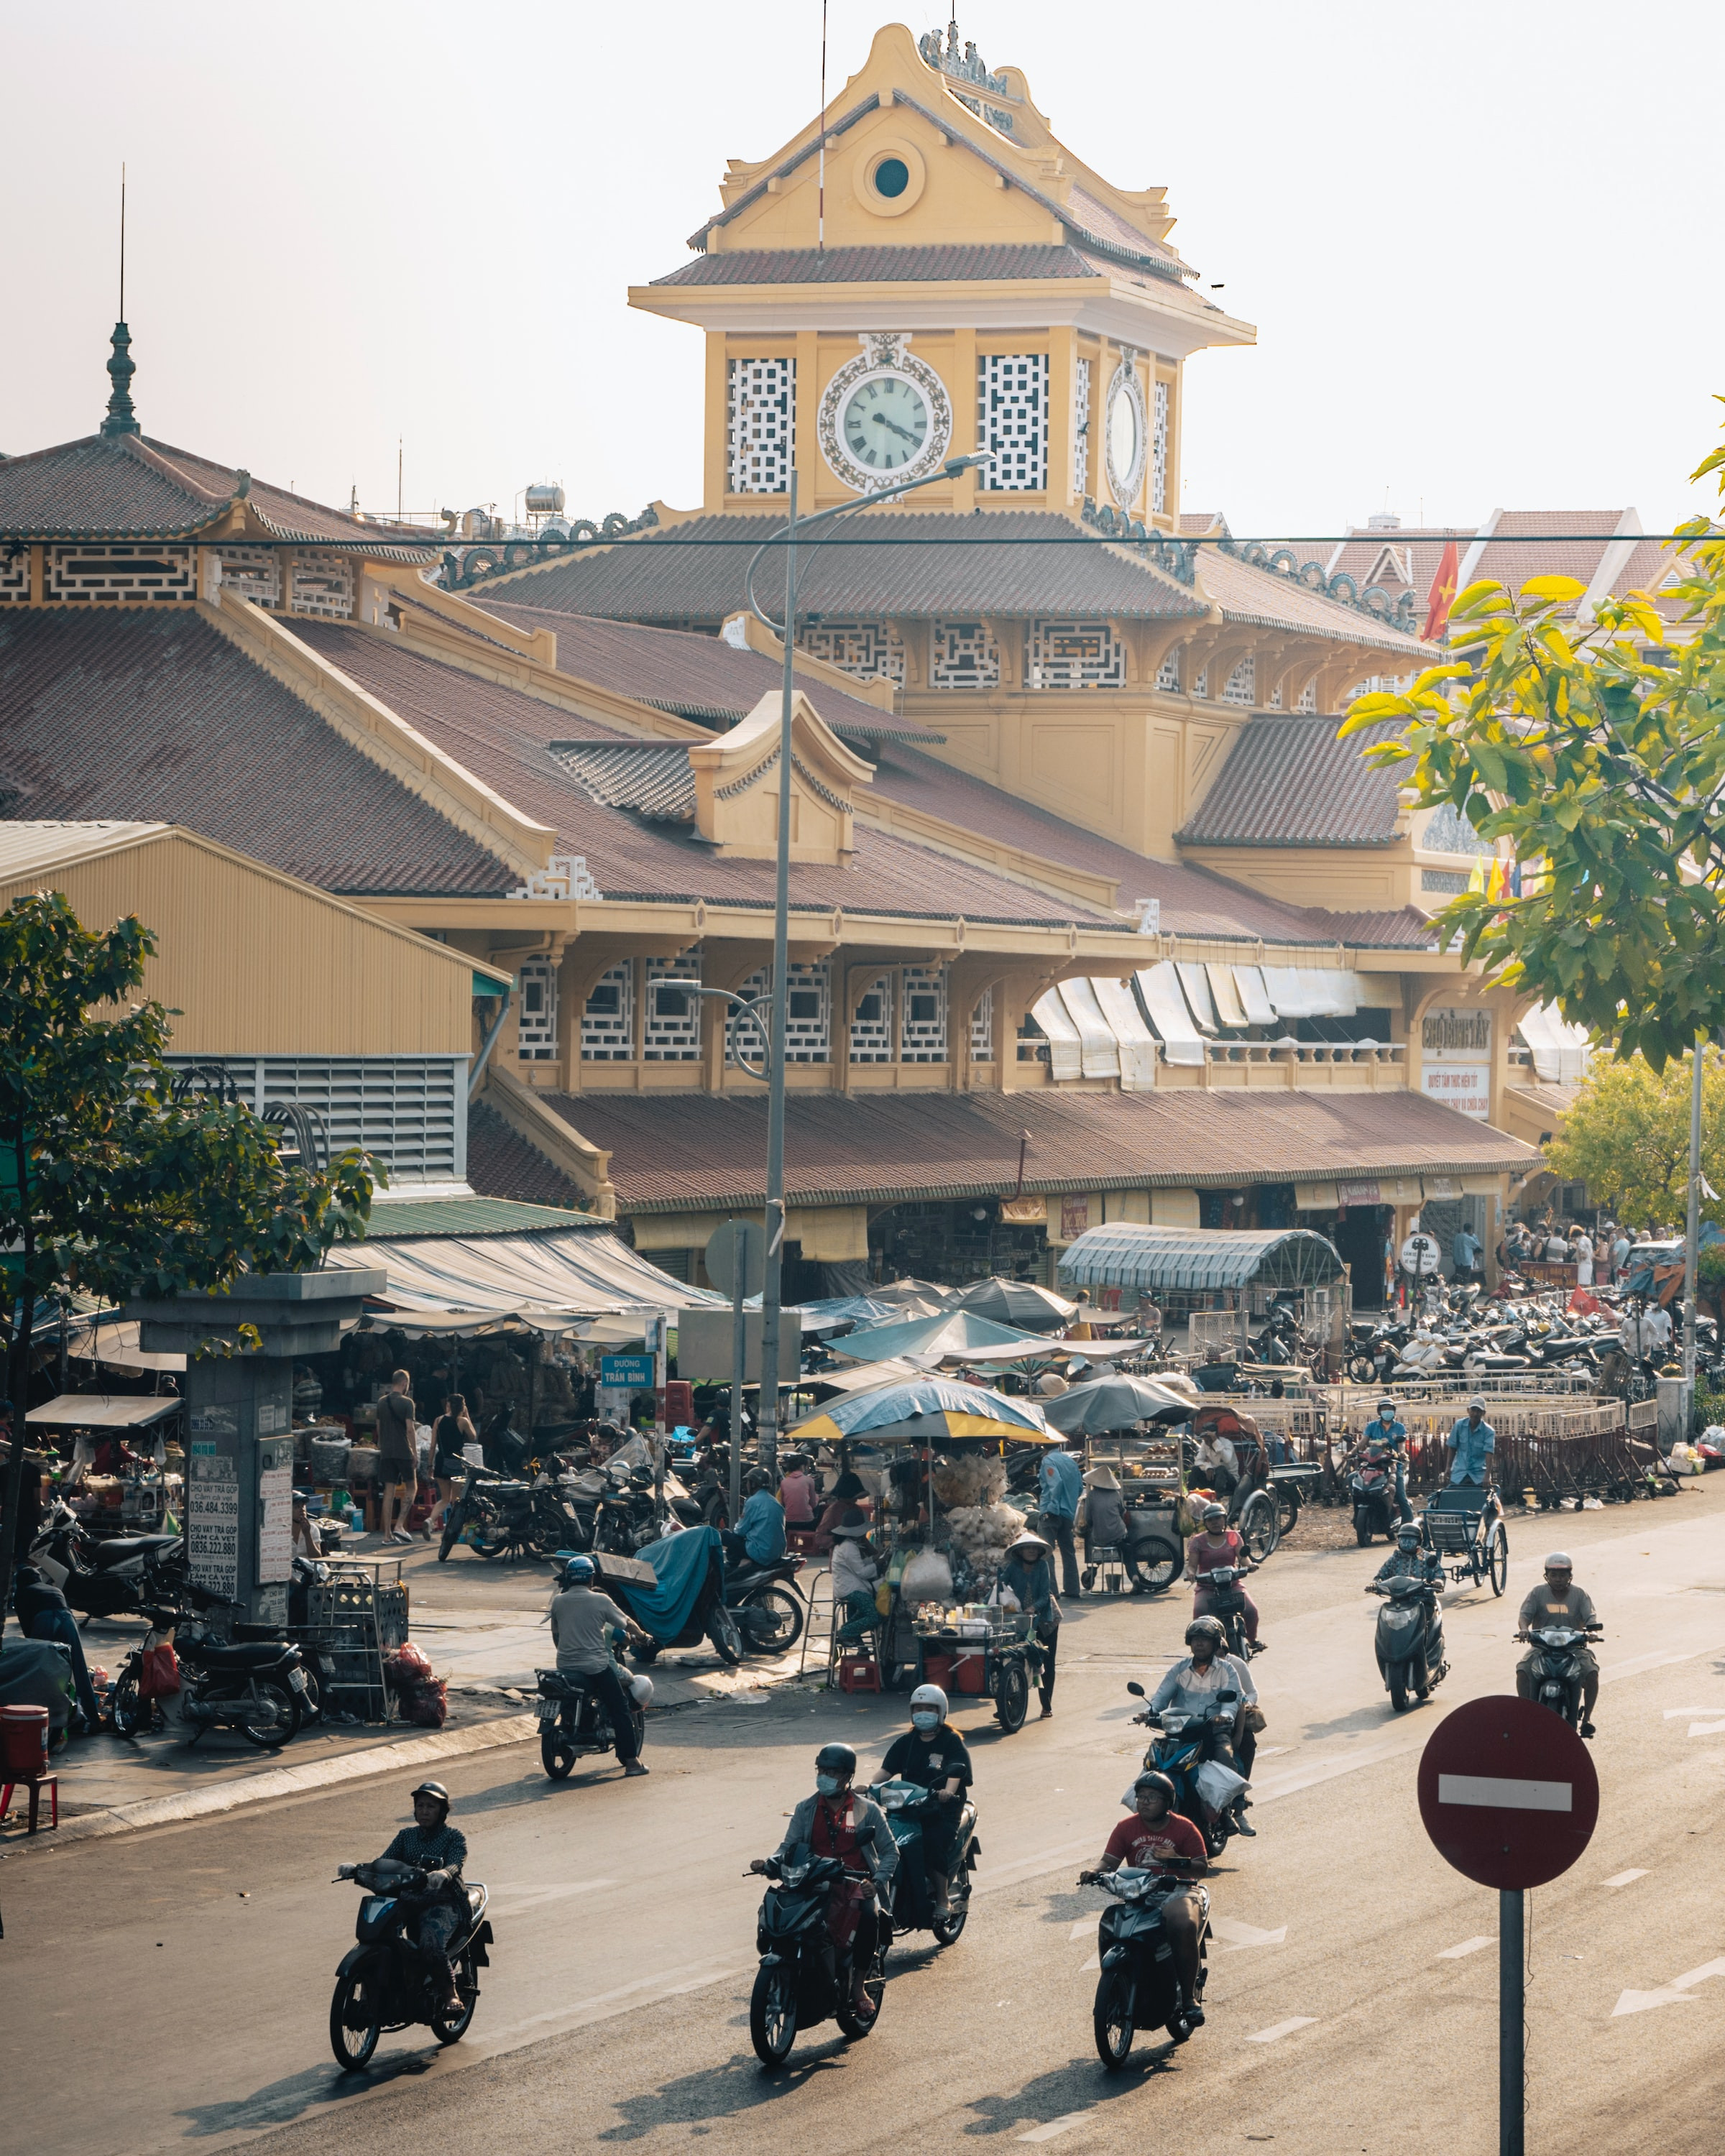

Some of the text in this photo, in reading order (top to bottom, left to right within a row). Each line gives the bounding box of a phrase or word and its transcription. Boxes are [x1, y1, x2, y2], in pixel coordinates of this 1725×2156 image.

[614, 1358, 640, 1368] ĐƯỜNG
[627, 1370, 645, 1383] BÌNH
[226, 1485, 237, 1494] GÓP
[190, 1501, 237, 1514] 036.484.3399
[226, 1524, 237, 1534] GÓP
[190, 1541, 236, 1555] 0836.222.880
[202, 1564, 212, 1572] VAY
[225, 1563, 236, 1574] GÓP
